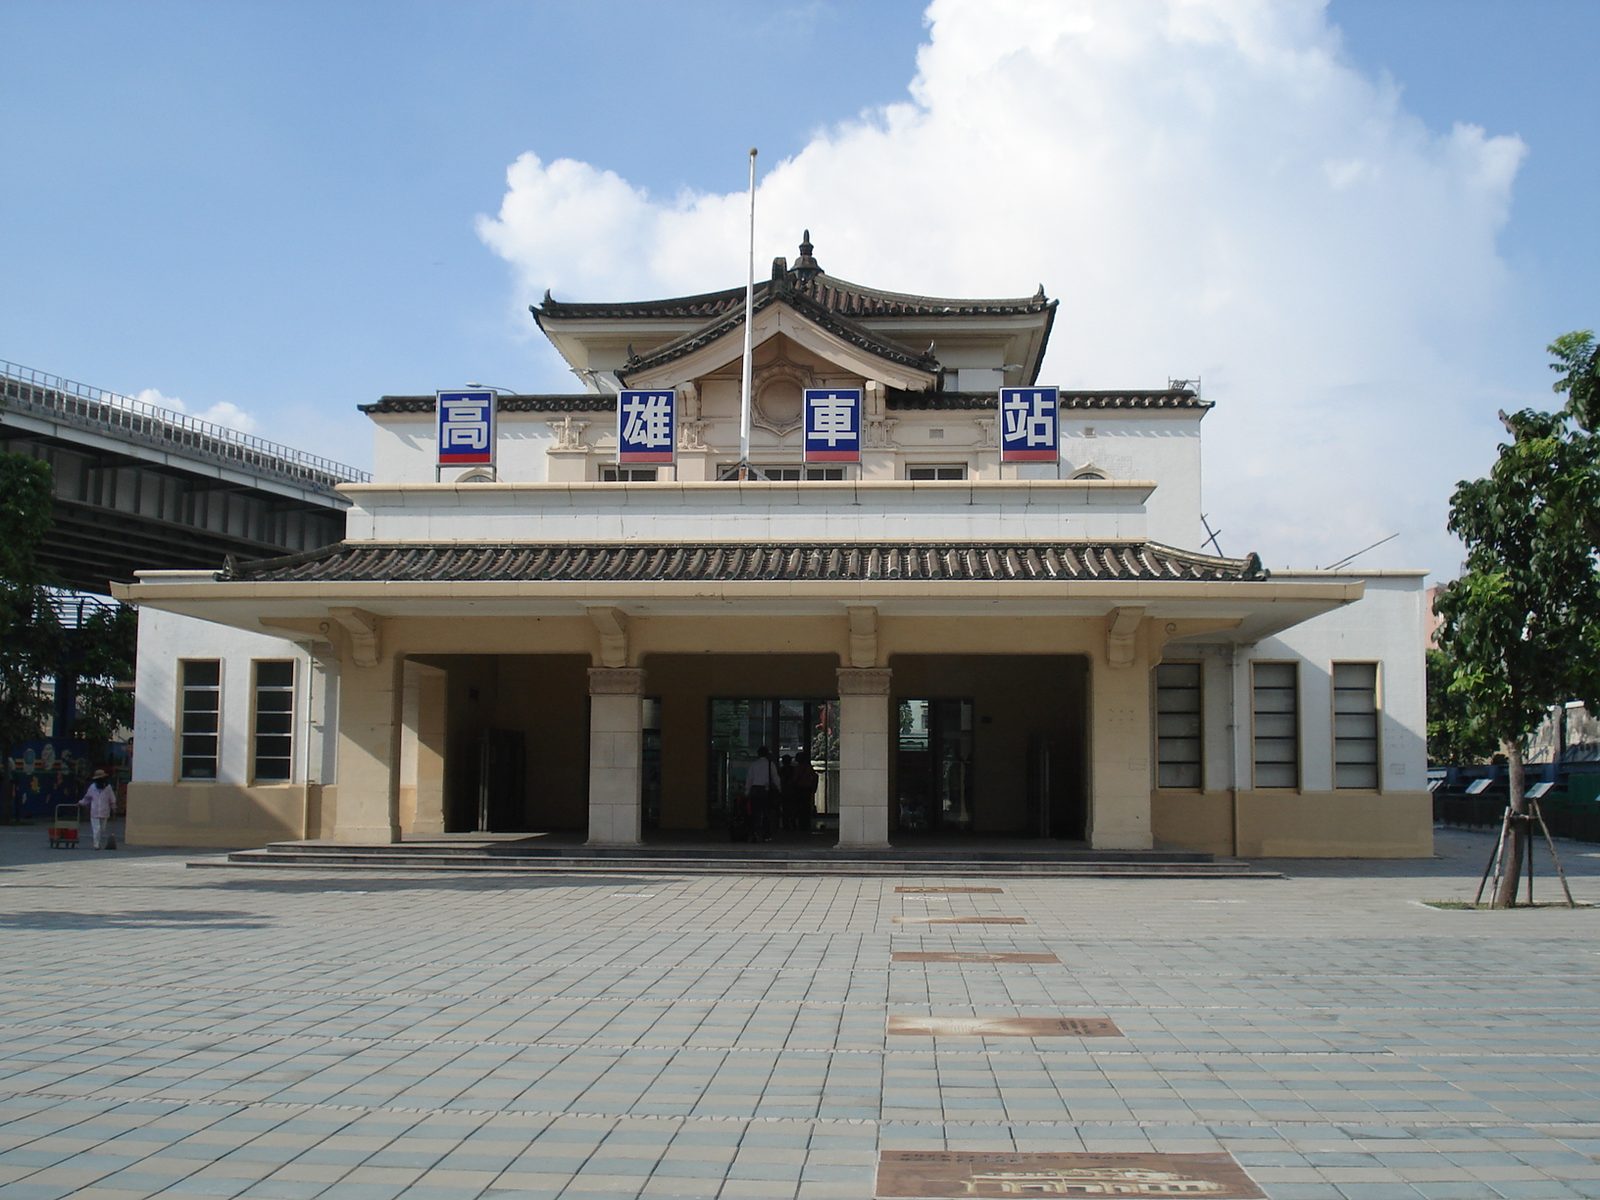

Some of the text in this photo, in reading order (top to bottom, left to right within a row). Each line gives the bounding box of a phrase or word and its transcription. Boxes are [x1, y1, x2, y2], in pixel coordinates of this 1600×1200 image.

[442, 393, 1054, 449] 高 雄 車 站
